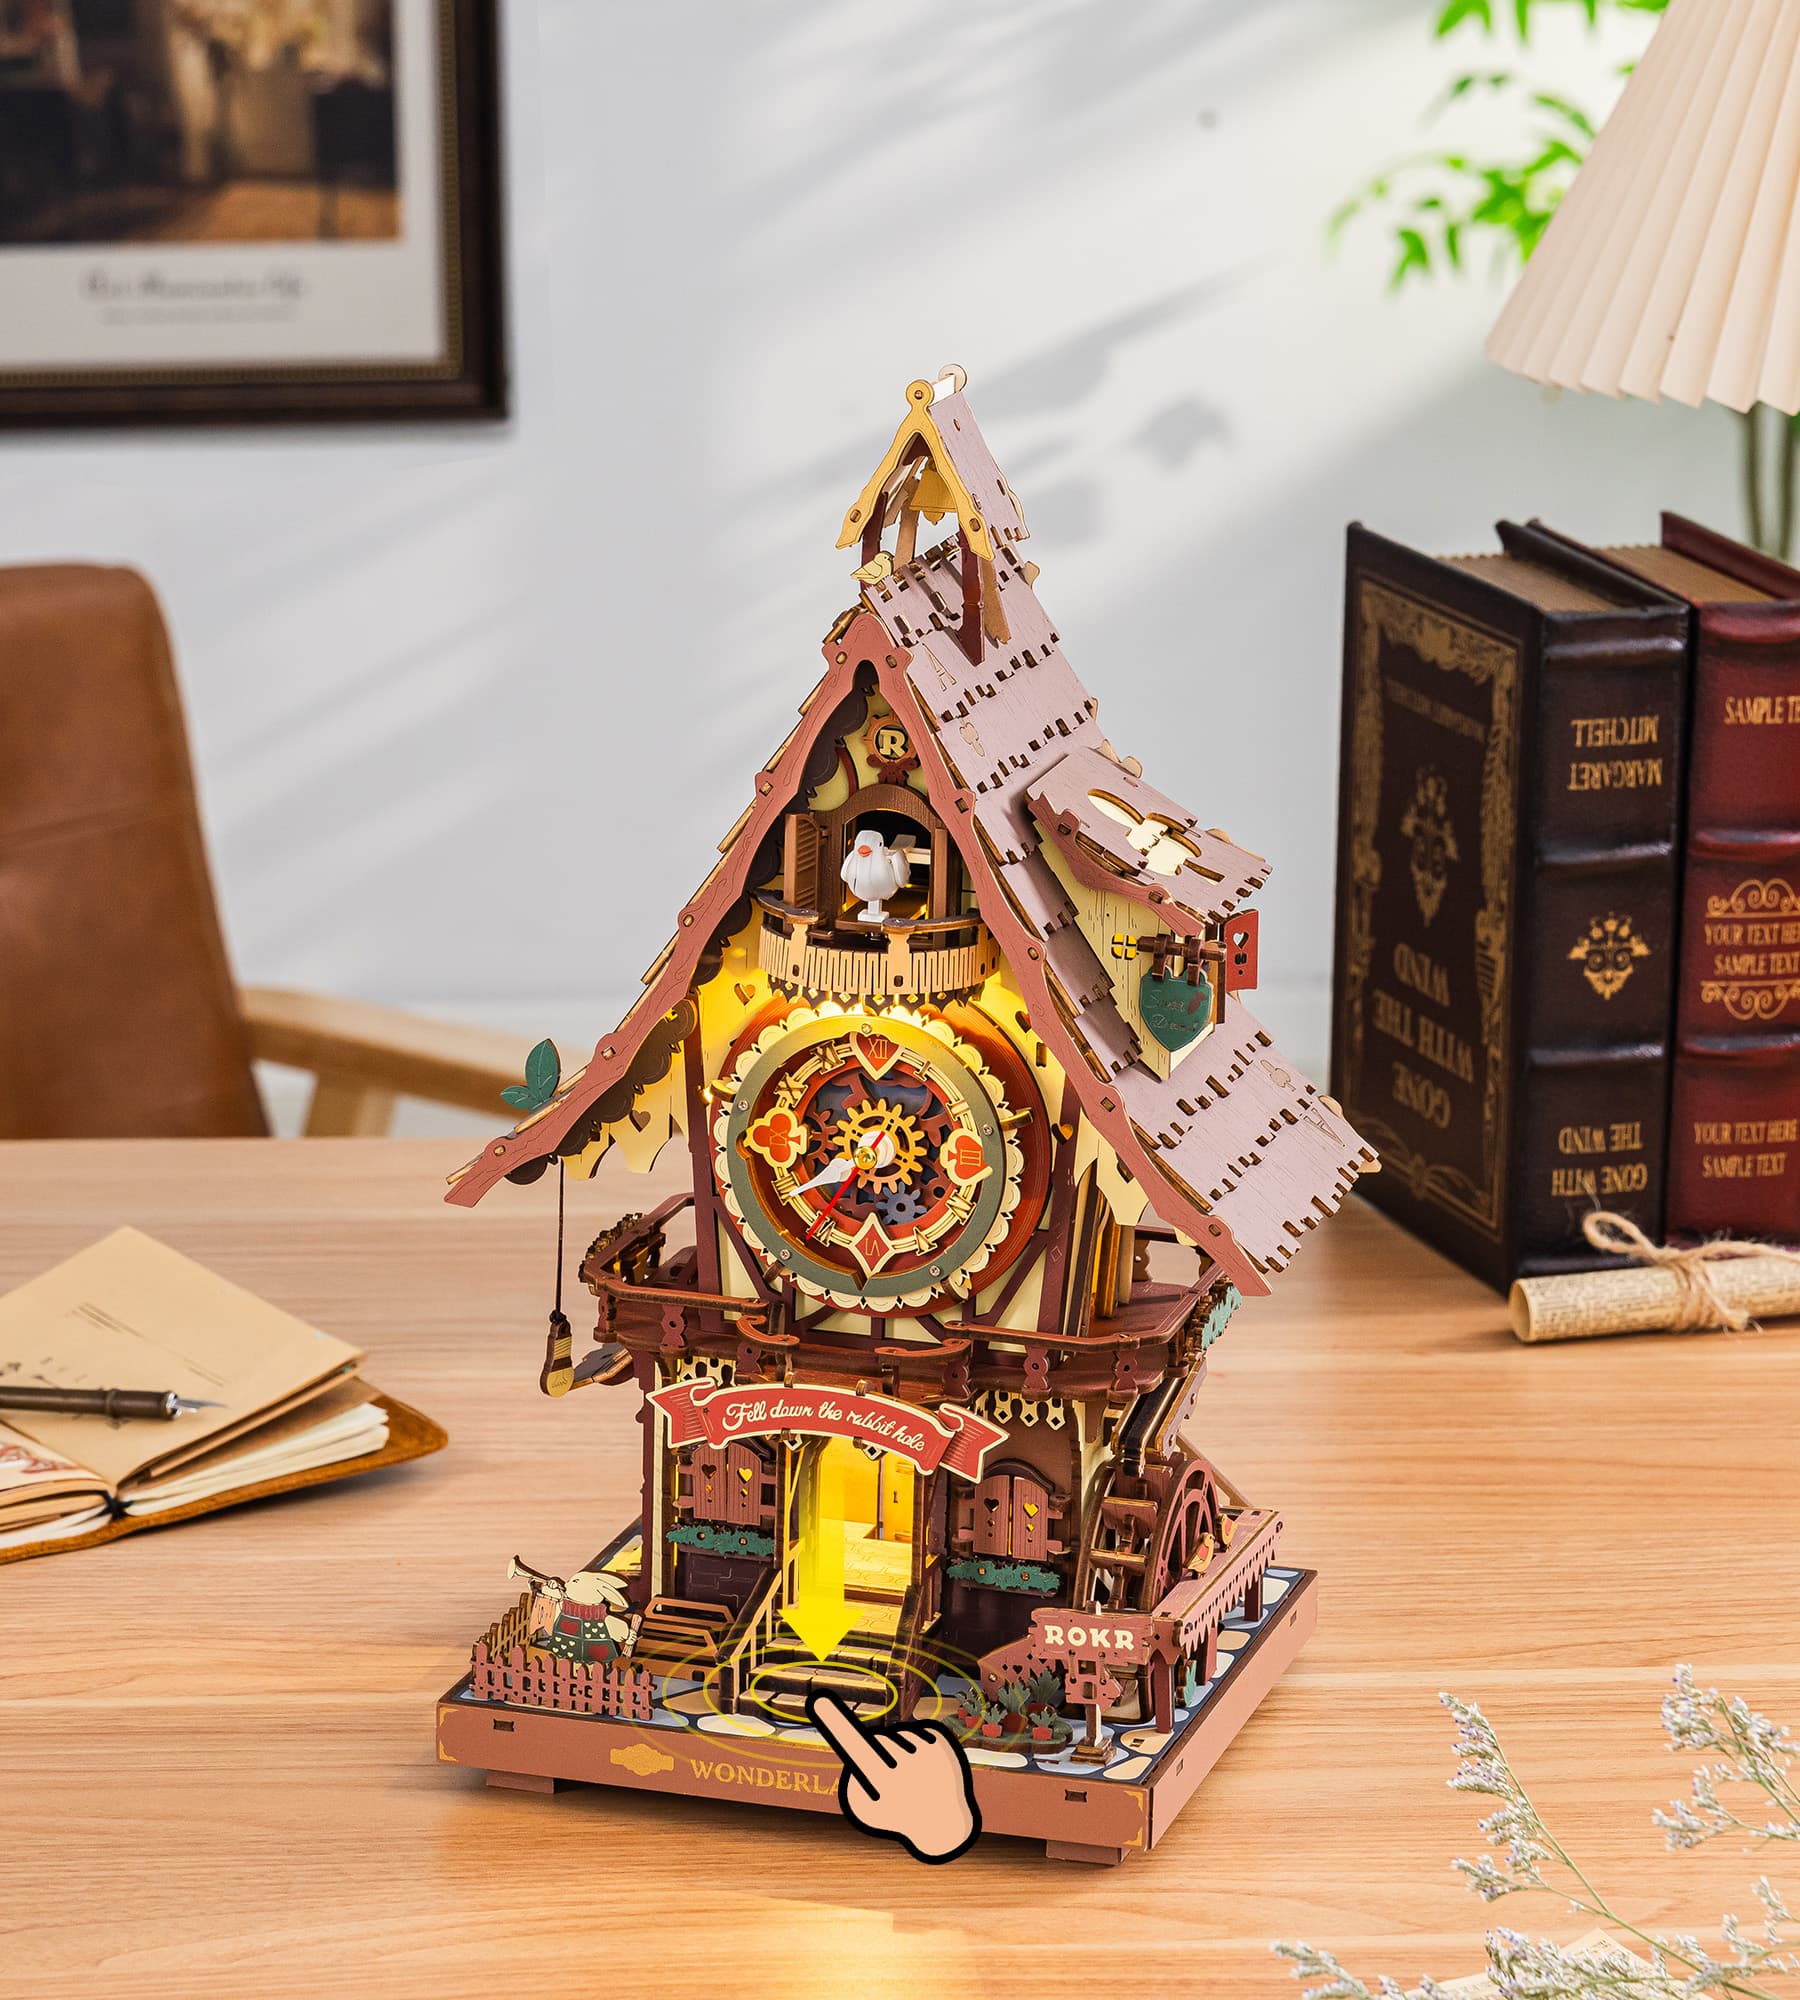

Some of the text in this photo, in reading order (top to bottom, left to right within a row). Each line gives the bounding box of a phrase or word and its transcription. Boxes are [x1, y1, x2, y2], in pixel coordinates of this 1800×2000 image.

[1723, 695, 1784, 725] SAMPLE
[879, 729, 907, 758] R
[1570, 714, 1659, 748] MITCHELL
[1567, 758, 1663, 791] MARGARET
[1704, 923, 1744, 946] YOUR
[1746, 922, 1779, 945] TEXT
[1393, 942, 1451, 1009] WIND
[1713, 951, 1800, 977] SAMPLE TEXT
[809, 1039, 846, 1075] XI
[867, 1037, 889, 1060] XII
[1417, 1014, 1475, 1085] WITH
[773, 1072, 809, 1108] X
[1558, 1120, 1644, 1155] THE WIND
[1693, 1121, 1732, 1145] YOUR
[1734, 1120, 1766, 1144] TEXT
[960, 1149, 982, 1167] III
[1702, 1152, 1786, 1178] SAMPLE TEXT
[1600, 1162, 1648, 1195] GONE
[865, 1237, 881, 1257] VI
[722, 1399, 926, 1452] Fell down the rabbit hole
[1044, 1625, 1134, 1651] ROKR
